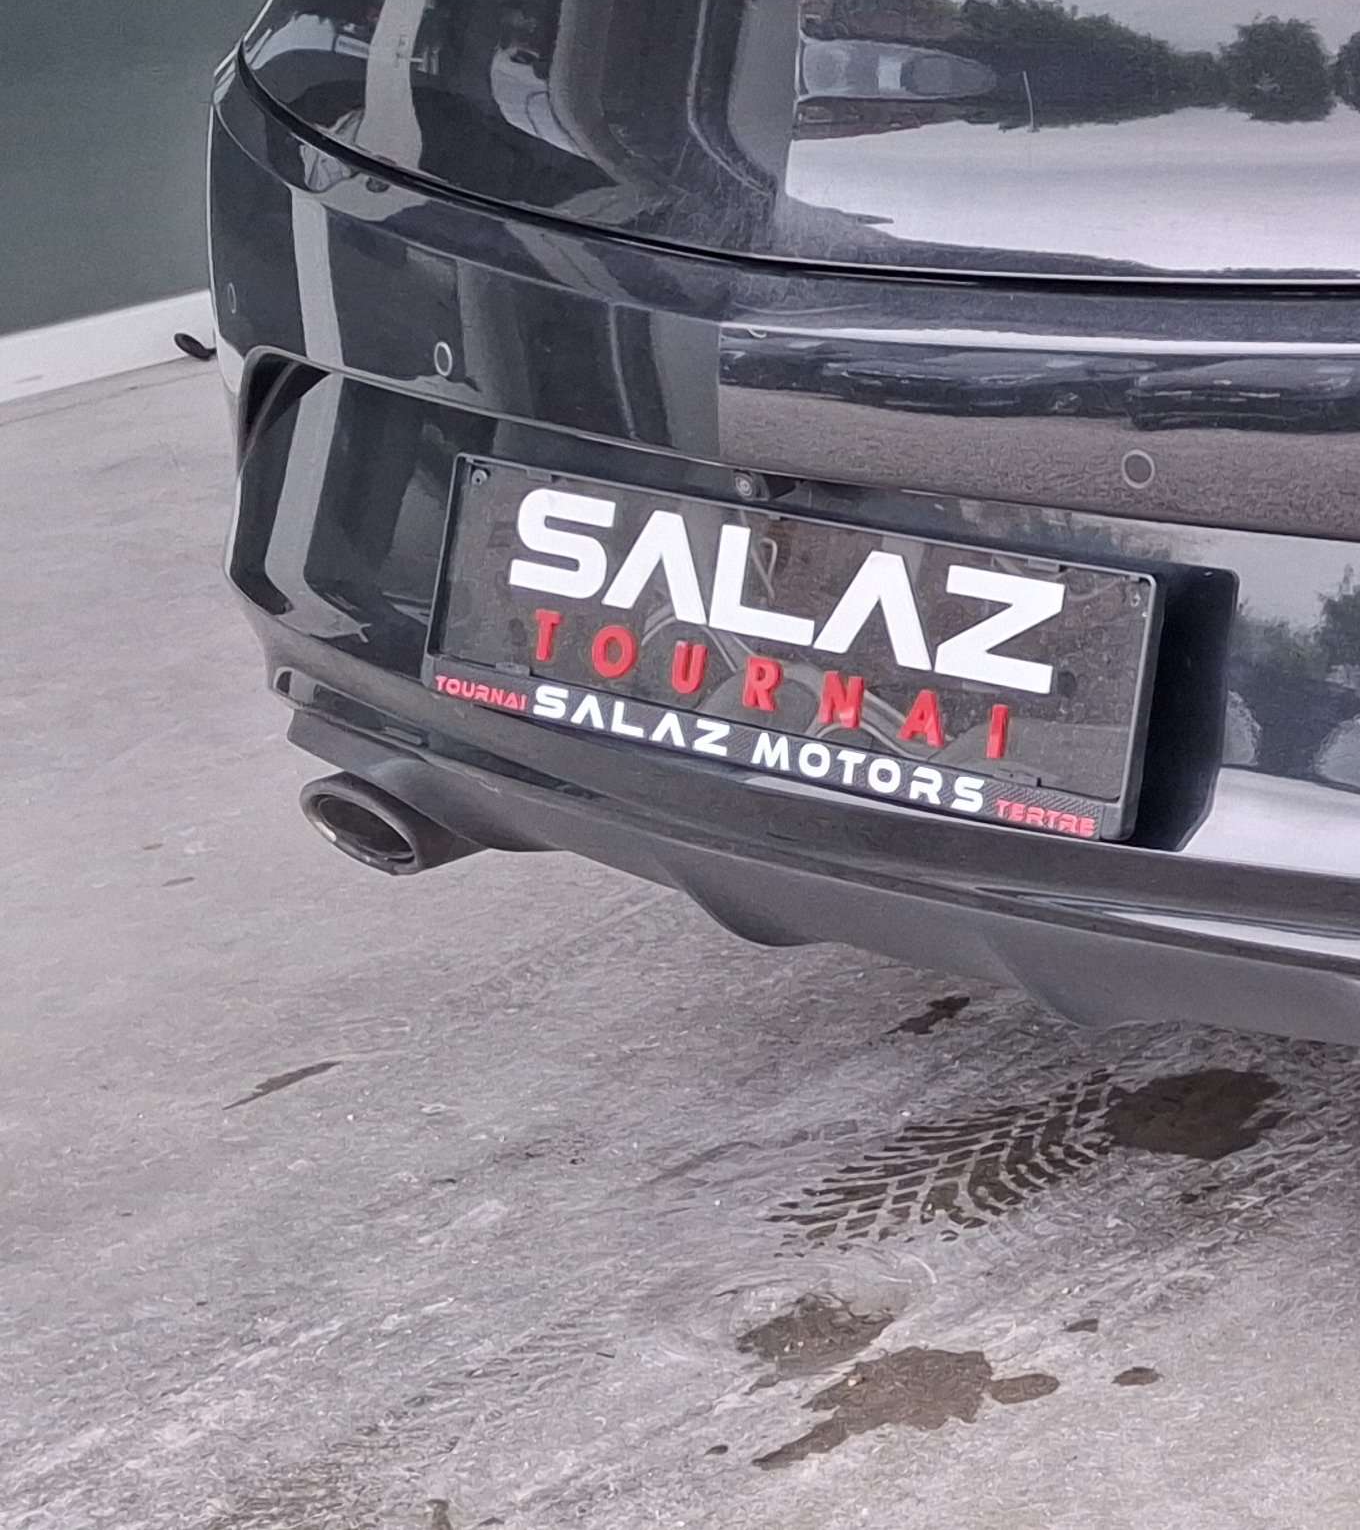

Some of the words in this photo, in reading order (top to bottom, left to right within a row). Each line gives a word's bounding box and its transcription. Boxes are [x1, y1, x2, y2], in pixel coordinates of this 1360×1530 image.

[508, 488, 1066, 695] SALAZ
[435, 675, 528, 712] TOURNAI
[533, 685, 731, 756] SALAZ
[750, 732, 985, 813] MOTORS
[995, 797, 1096, 838] TERTRE
[533, 609, 1010, 760] TOURNAI
